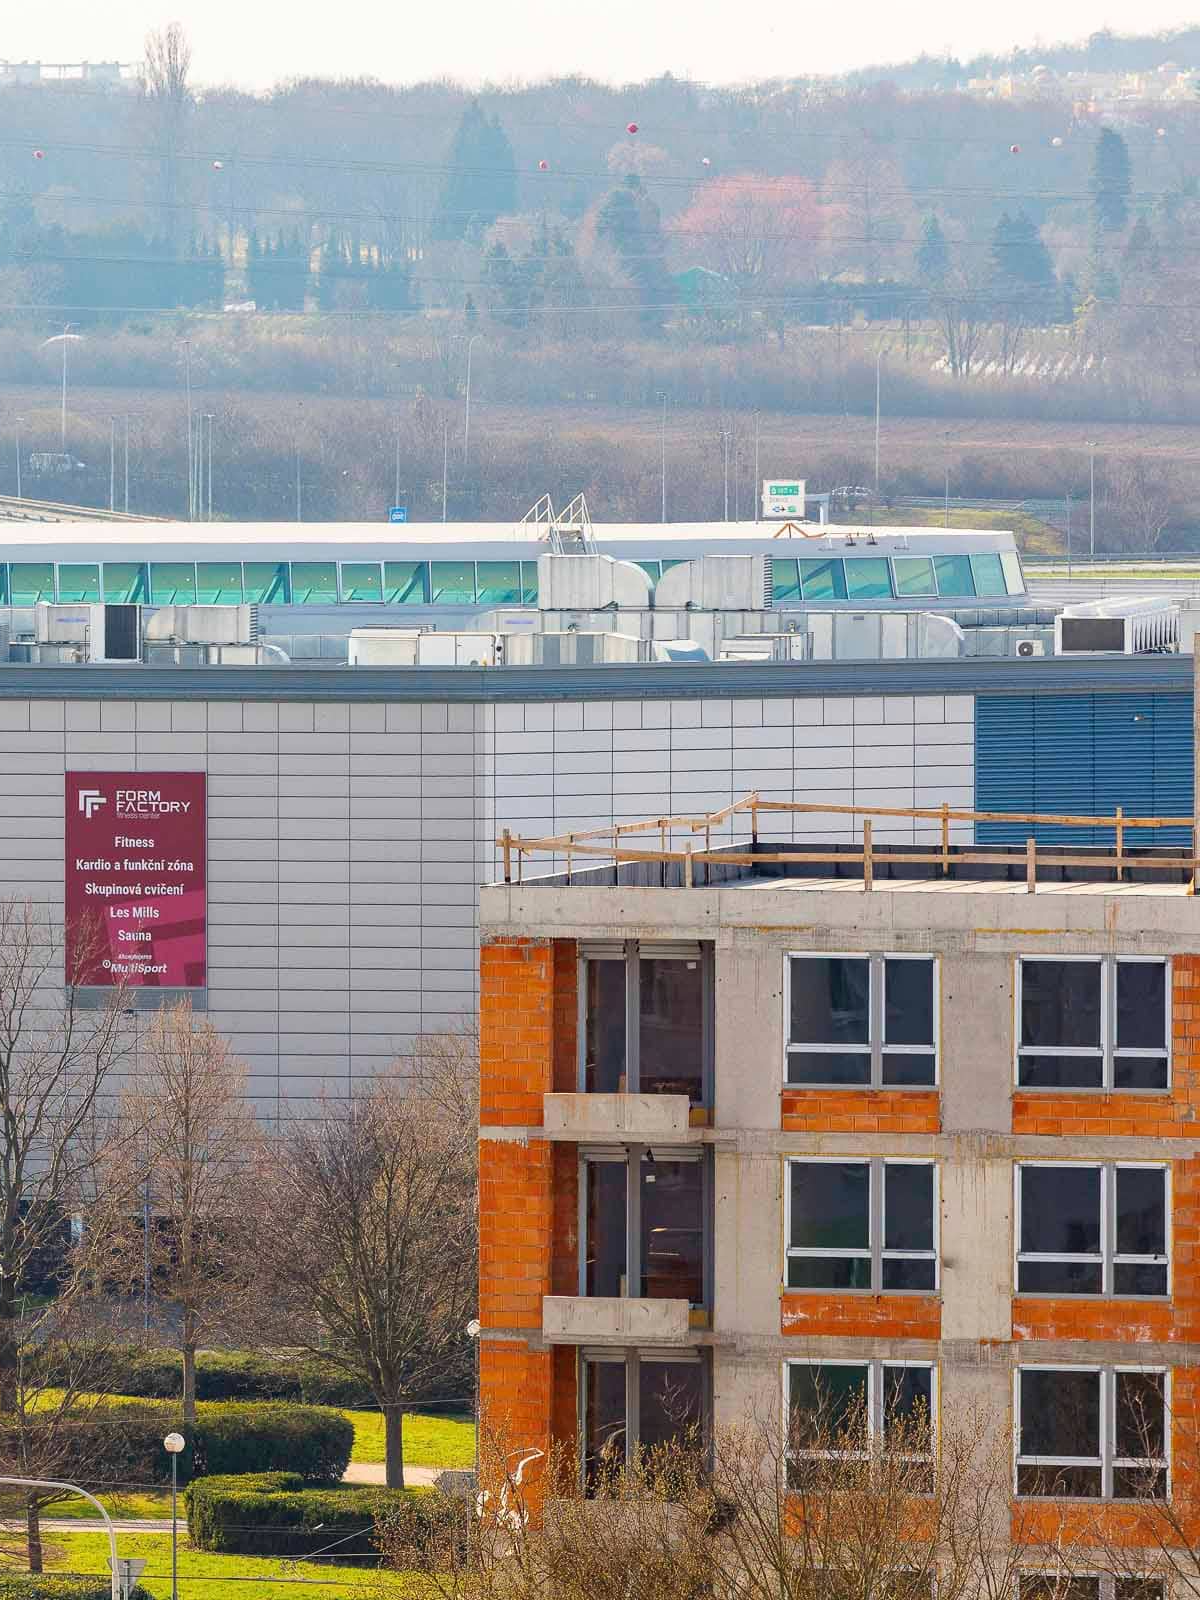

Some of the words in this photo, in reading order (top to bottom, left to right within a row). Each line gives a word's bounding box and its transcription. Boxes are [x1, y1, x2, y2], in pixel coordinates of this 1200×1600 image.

[116, 790, 161, 801] FORM
[116, 801, 191, 813] FACTORY
[114, 836, 155, 848] Fitness
[76, 859, 111, 871] Kardio
[114, 862, 121, 871] a
[123, 859, 165, 871] funkční
[167, 860, 194, 871] zóna
[85, 883, 141, 897] Skupinová
[144, 883, 184, 895] cvičení
[110, 906, 130, 919] Les
[132, 906, 160, 919] Mills
[118, 929, 152, 941] Sauna
